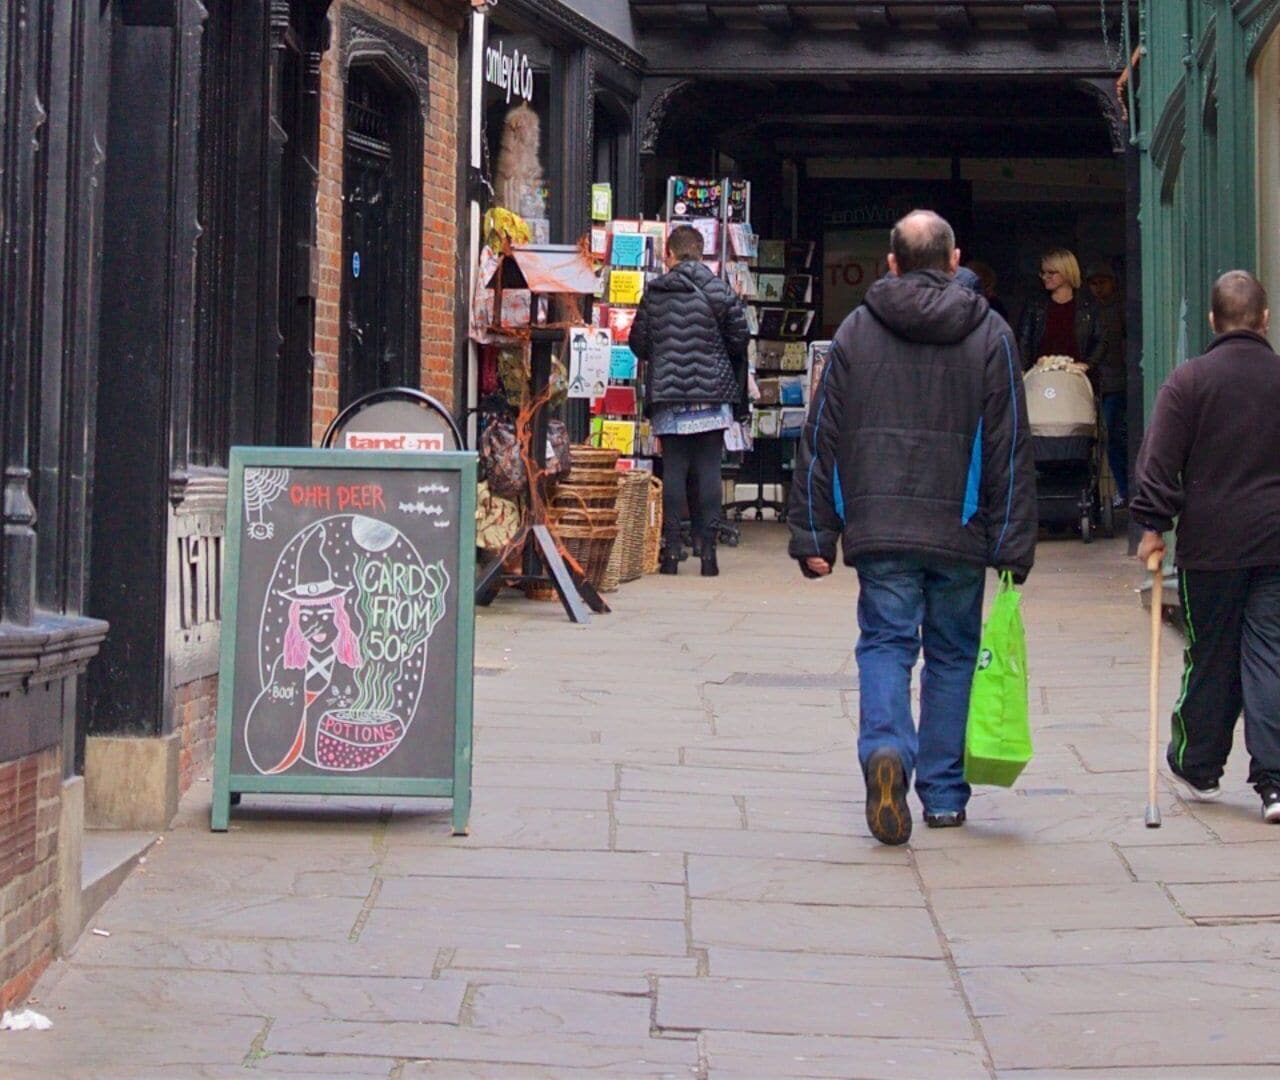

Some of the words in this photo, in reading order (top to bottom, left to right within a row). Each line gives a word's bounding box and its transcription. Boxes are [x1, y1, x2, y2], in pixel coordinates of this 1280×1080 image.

[513, 49, 520, 95] &
[521, 54, 533, 101] Co
[289, 484, 332, 511] OHH
[335, 483, 388, 514] DEER
[363, 561, 439, 599] CARDS
[373, 595, 431, 632] FROM
[368, 631, 408, 662] 50p
